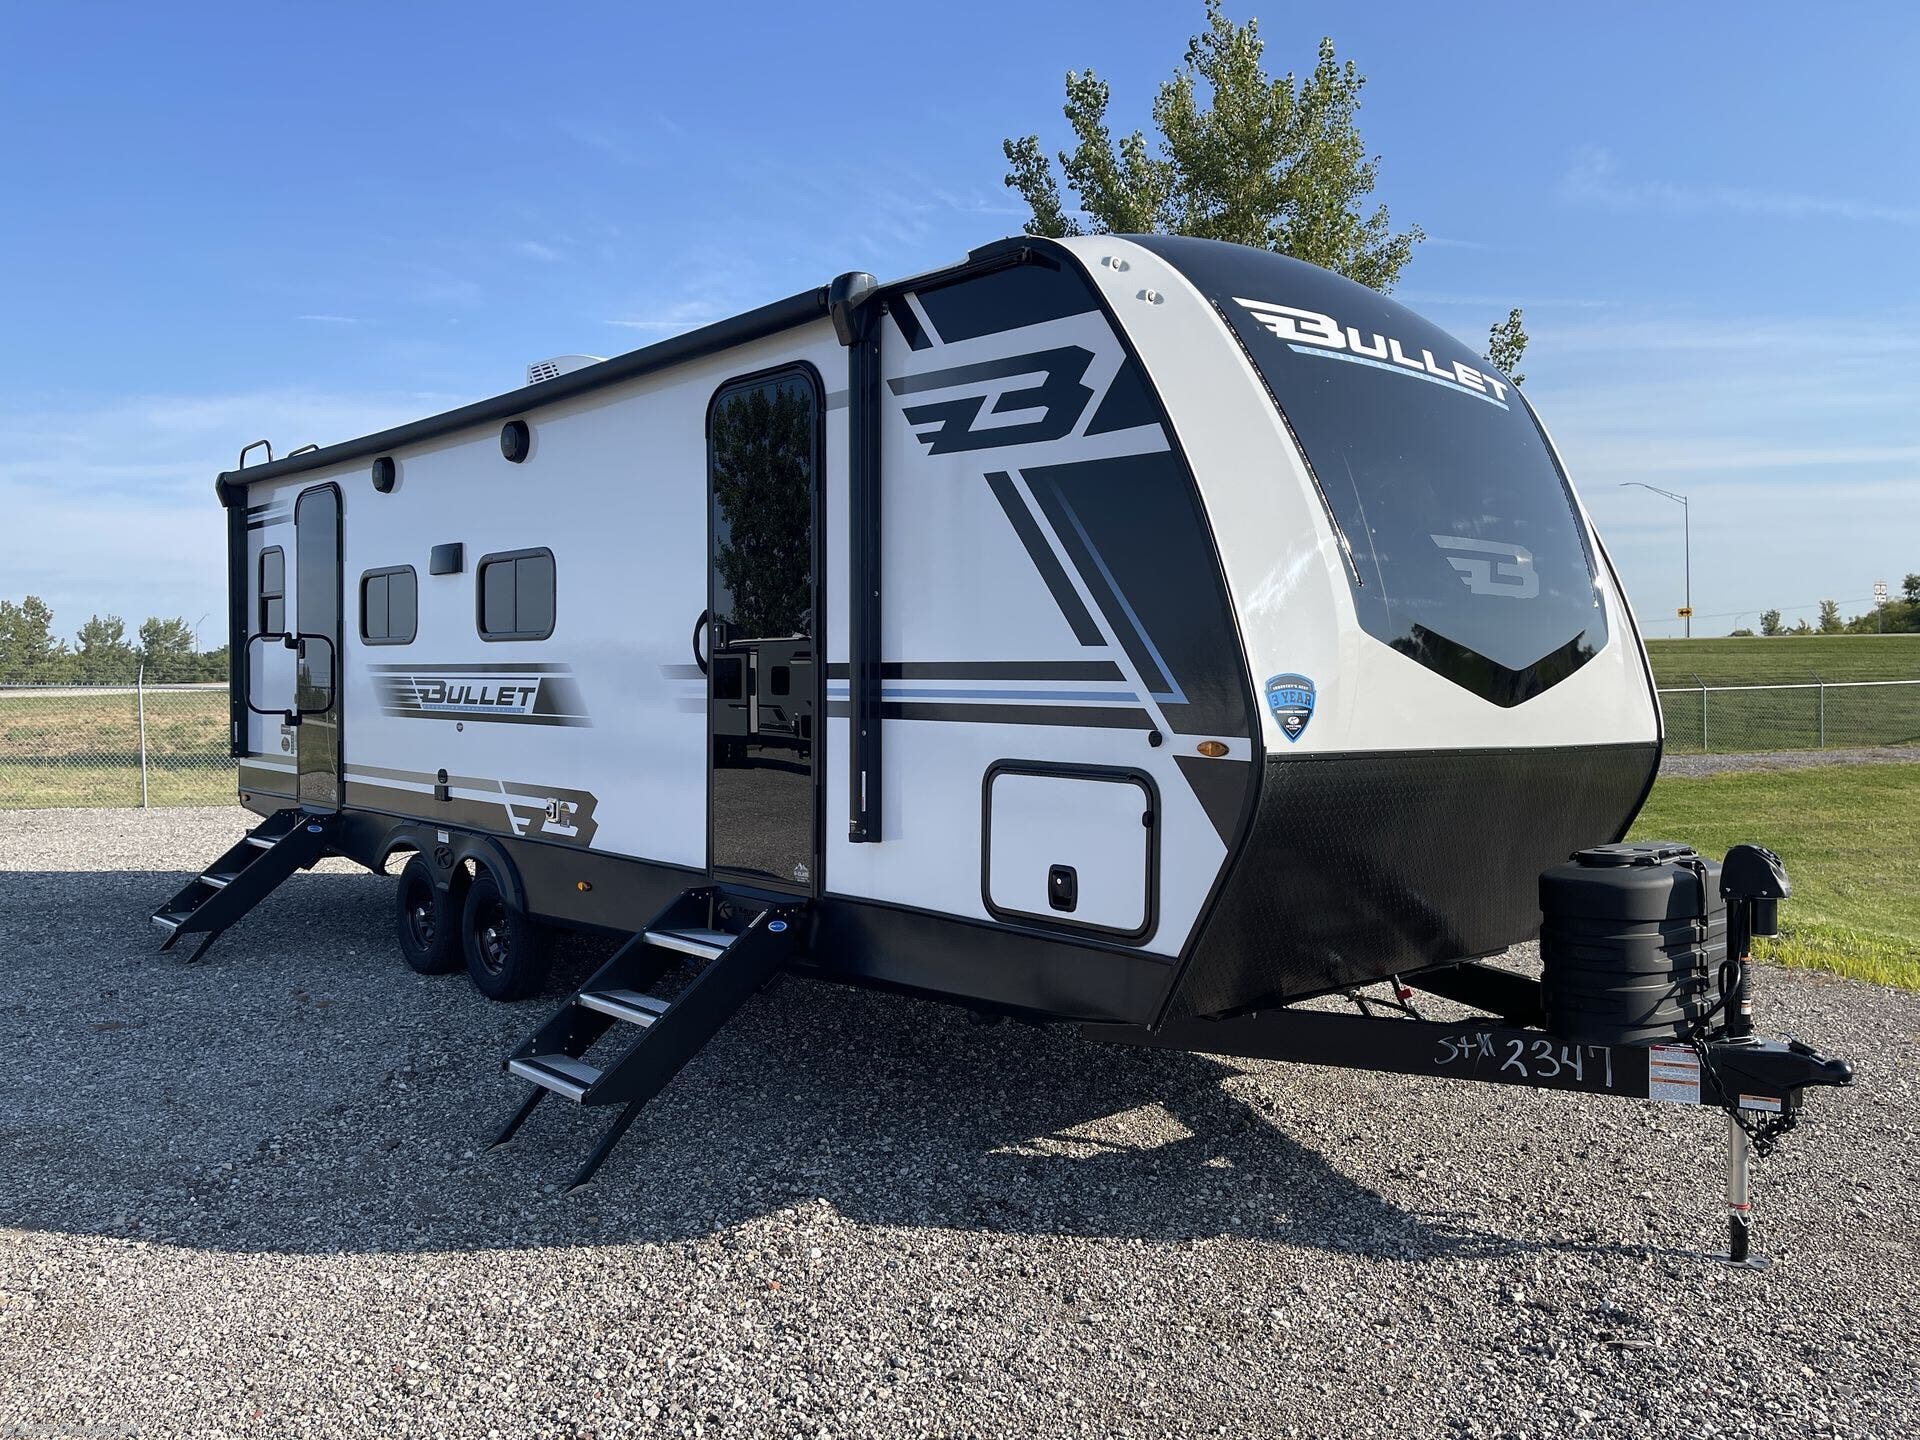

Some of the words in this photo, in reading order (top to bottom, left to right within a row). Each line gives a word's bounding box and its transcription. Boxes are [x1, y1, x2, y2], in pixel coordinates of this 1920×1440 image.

[1232, 297, 1509, 400] BULLET
[413, 680, 537, 707] BULLET
[1271, 693, 1280, 706] 3
[1281, 691, 1312, 706] YEAR
[1500, 1039, 1612, 1088] 2347
